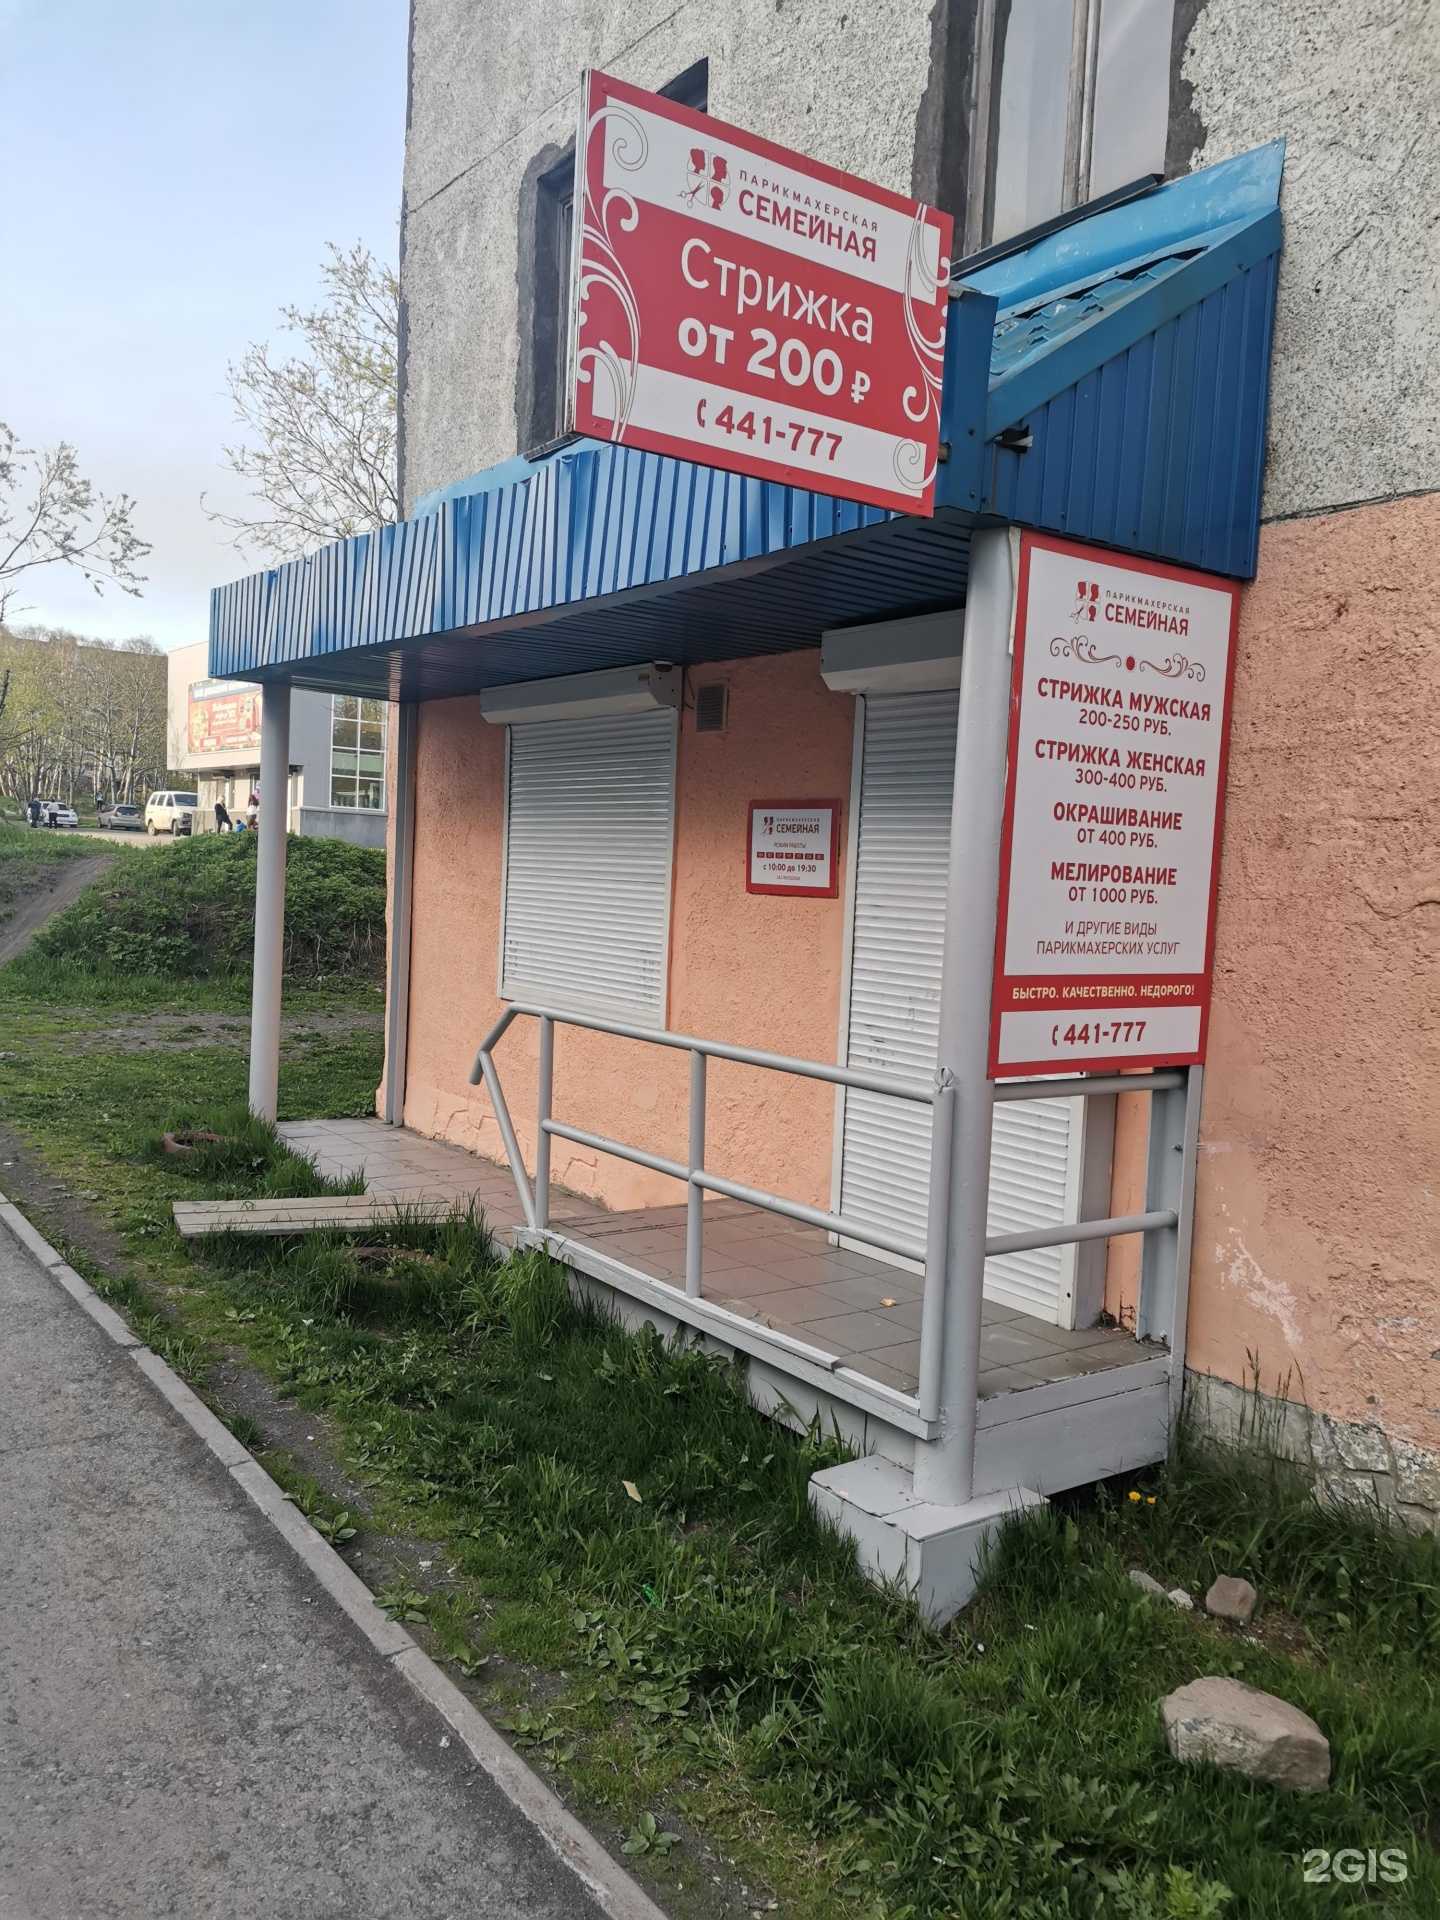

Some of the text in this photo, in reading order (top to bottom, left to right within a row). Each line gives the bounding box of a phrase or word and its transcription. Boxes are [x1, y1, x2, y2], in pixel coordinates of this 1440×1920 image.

[739, 169, 879, 233] ПАРИКМАХЕРСКАЯ
[738, 189, 877, 262] СЕМЕЙНАЯ
[681, 237, 873, 345] Стрижка
[678, 317, 734, 365] от
[746, 327, 844, 397] 200
[715, 404, 843, 461] 441-777
[1105, 590, 1190, 615] ПАРИКМАХЕРСКАЯ
[1104, 603, 1189, 636] СЕМЕЙНАЯ
[1037, 677, 1211, 722] СТРИЖКА МУЖСКАЯ
[1079, 708, 1172, 737] 200-250 РУБ.
[1035, 739, 1206, 777] СТРИЖКА ЖЕНСКАЯ
[1075, 768, 1168, 793] 300-400 РУБ.
[1053, 801, 1183, 830] ОКРАШИВАНИЕ
[1077, 828, 1158, 849] ОТ 400 РУБ.
[1051, 861, 1178, 885] МЕЛИРОВАНИЕ
[1068, 886, 1159, 904] ОТ 1000 РУБ.
[1065, 921, 1157, 937] И ДРУГИЕ ВИДЫ
[1036, 940, 1181, 955] ПАРИКМАХЕРСКИХ УСЛУГ
[1012, 984, 1195, 1000] БЫСТРО. КАЧЕСТВЕННО. НЕДОРОГО!
[1063, 1021, 1147, 1046] 441-777
